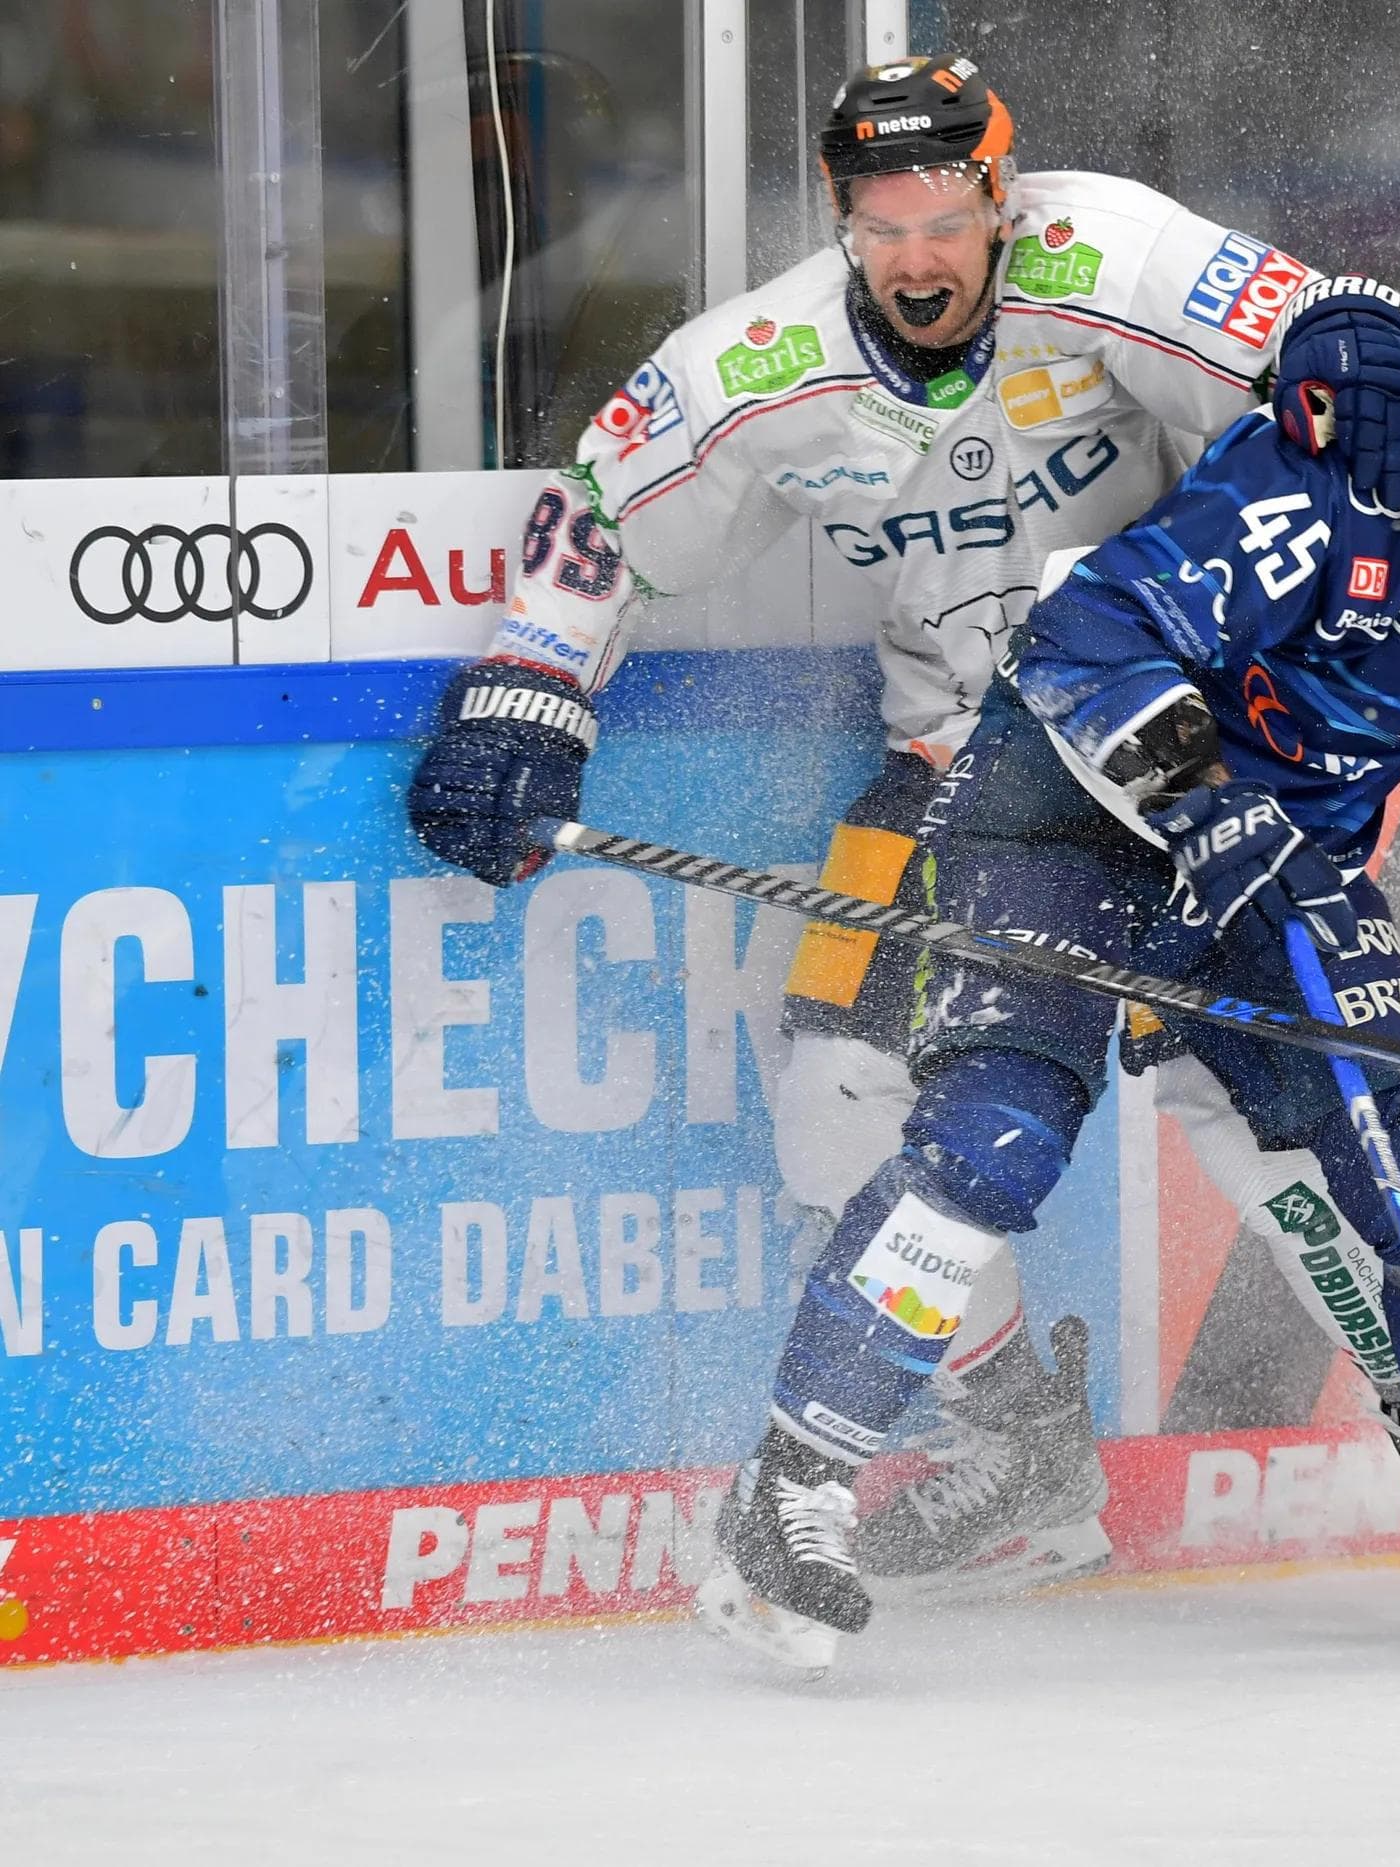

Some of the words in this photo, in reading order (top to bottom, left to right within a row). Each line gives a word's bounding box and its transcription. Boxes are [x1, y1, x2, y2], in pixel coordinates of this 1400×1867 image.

[878, 115, 932, 135] netgo
[1008, 250, 1092, 288] Karls
[1186, 231, 1268, 324] LIQUI
[1228, 251, 1306, 342] MOLY
[723, 337, 818, 390] Karls
[521, 486, 626, 601] 89
[822, 428, 1120, 567] GASAG
[357, 528, 506, 608] Au
[1239, 493, 1332, 601] 45
[93, 1208, 393, 1352] CARD
[381, 1486, 726, 1610] PENN
